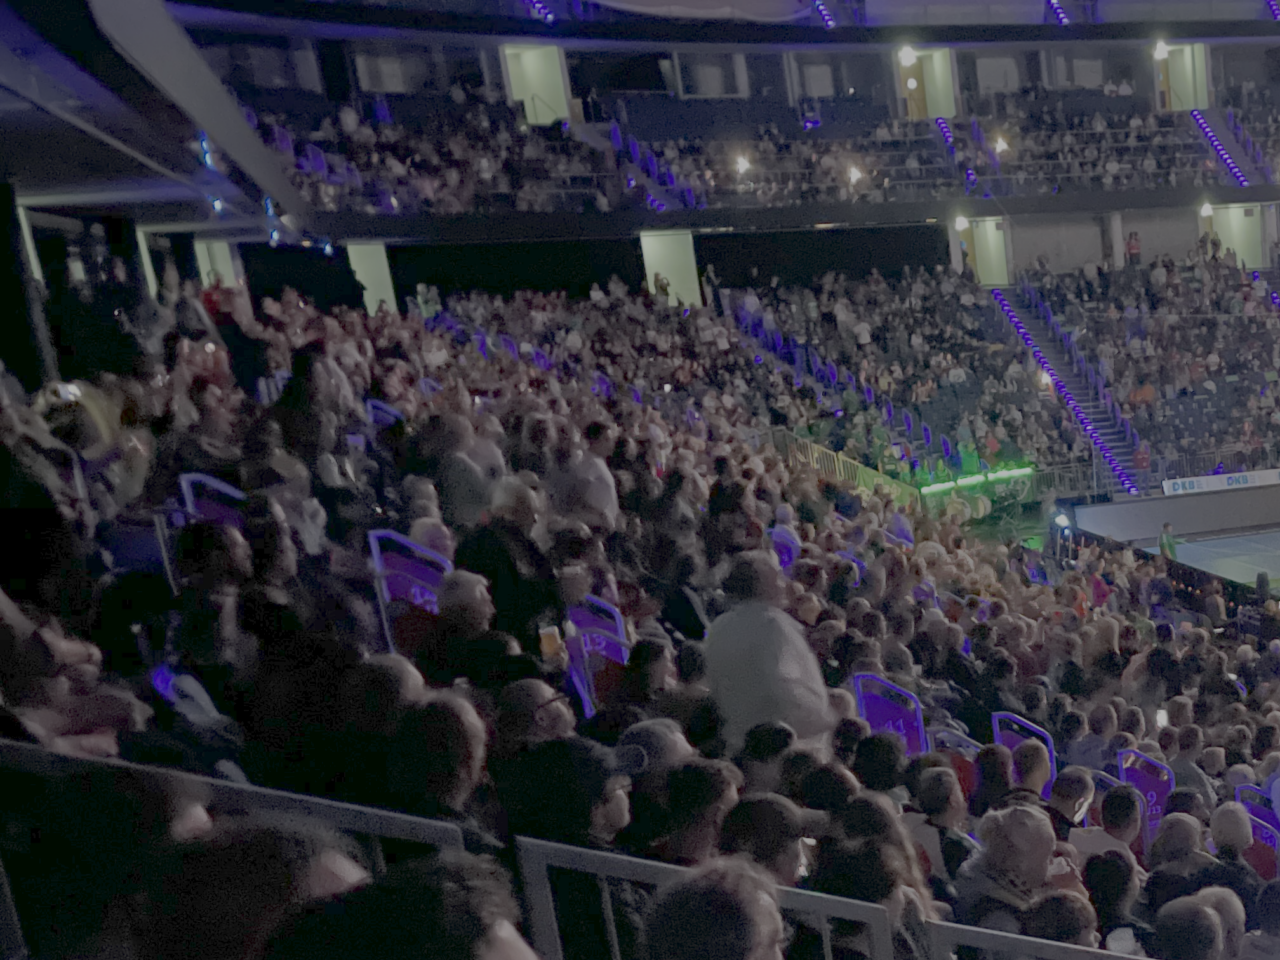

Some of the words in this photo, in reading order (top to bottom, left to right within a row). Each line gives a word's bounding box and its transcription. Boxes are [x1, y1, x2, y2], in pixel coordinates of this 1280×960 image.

[1172, 480, 1195, 492] DKB
[1227, 475, 1249, 486] DKB
[1146, 791, 1157, 806] 9
